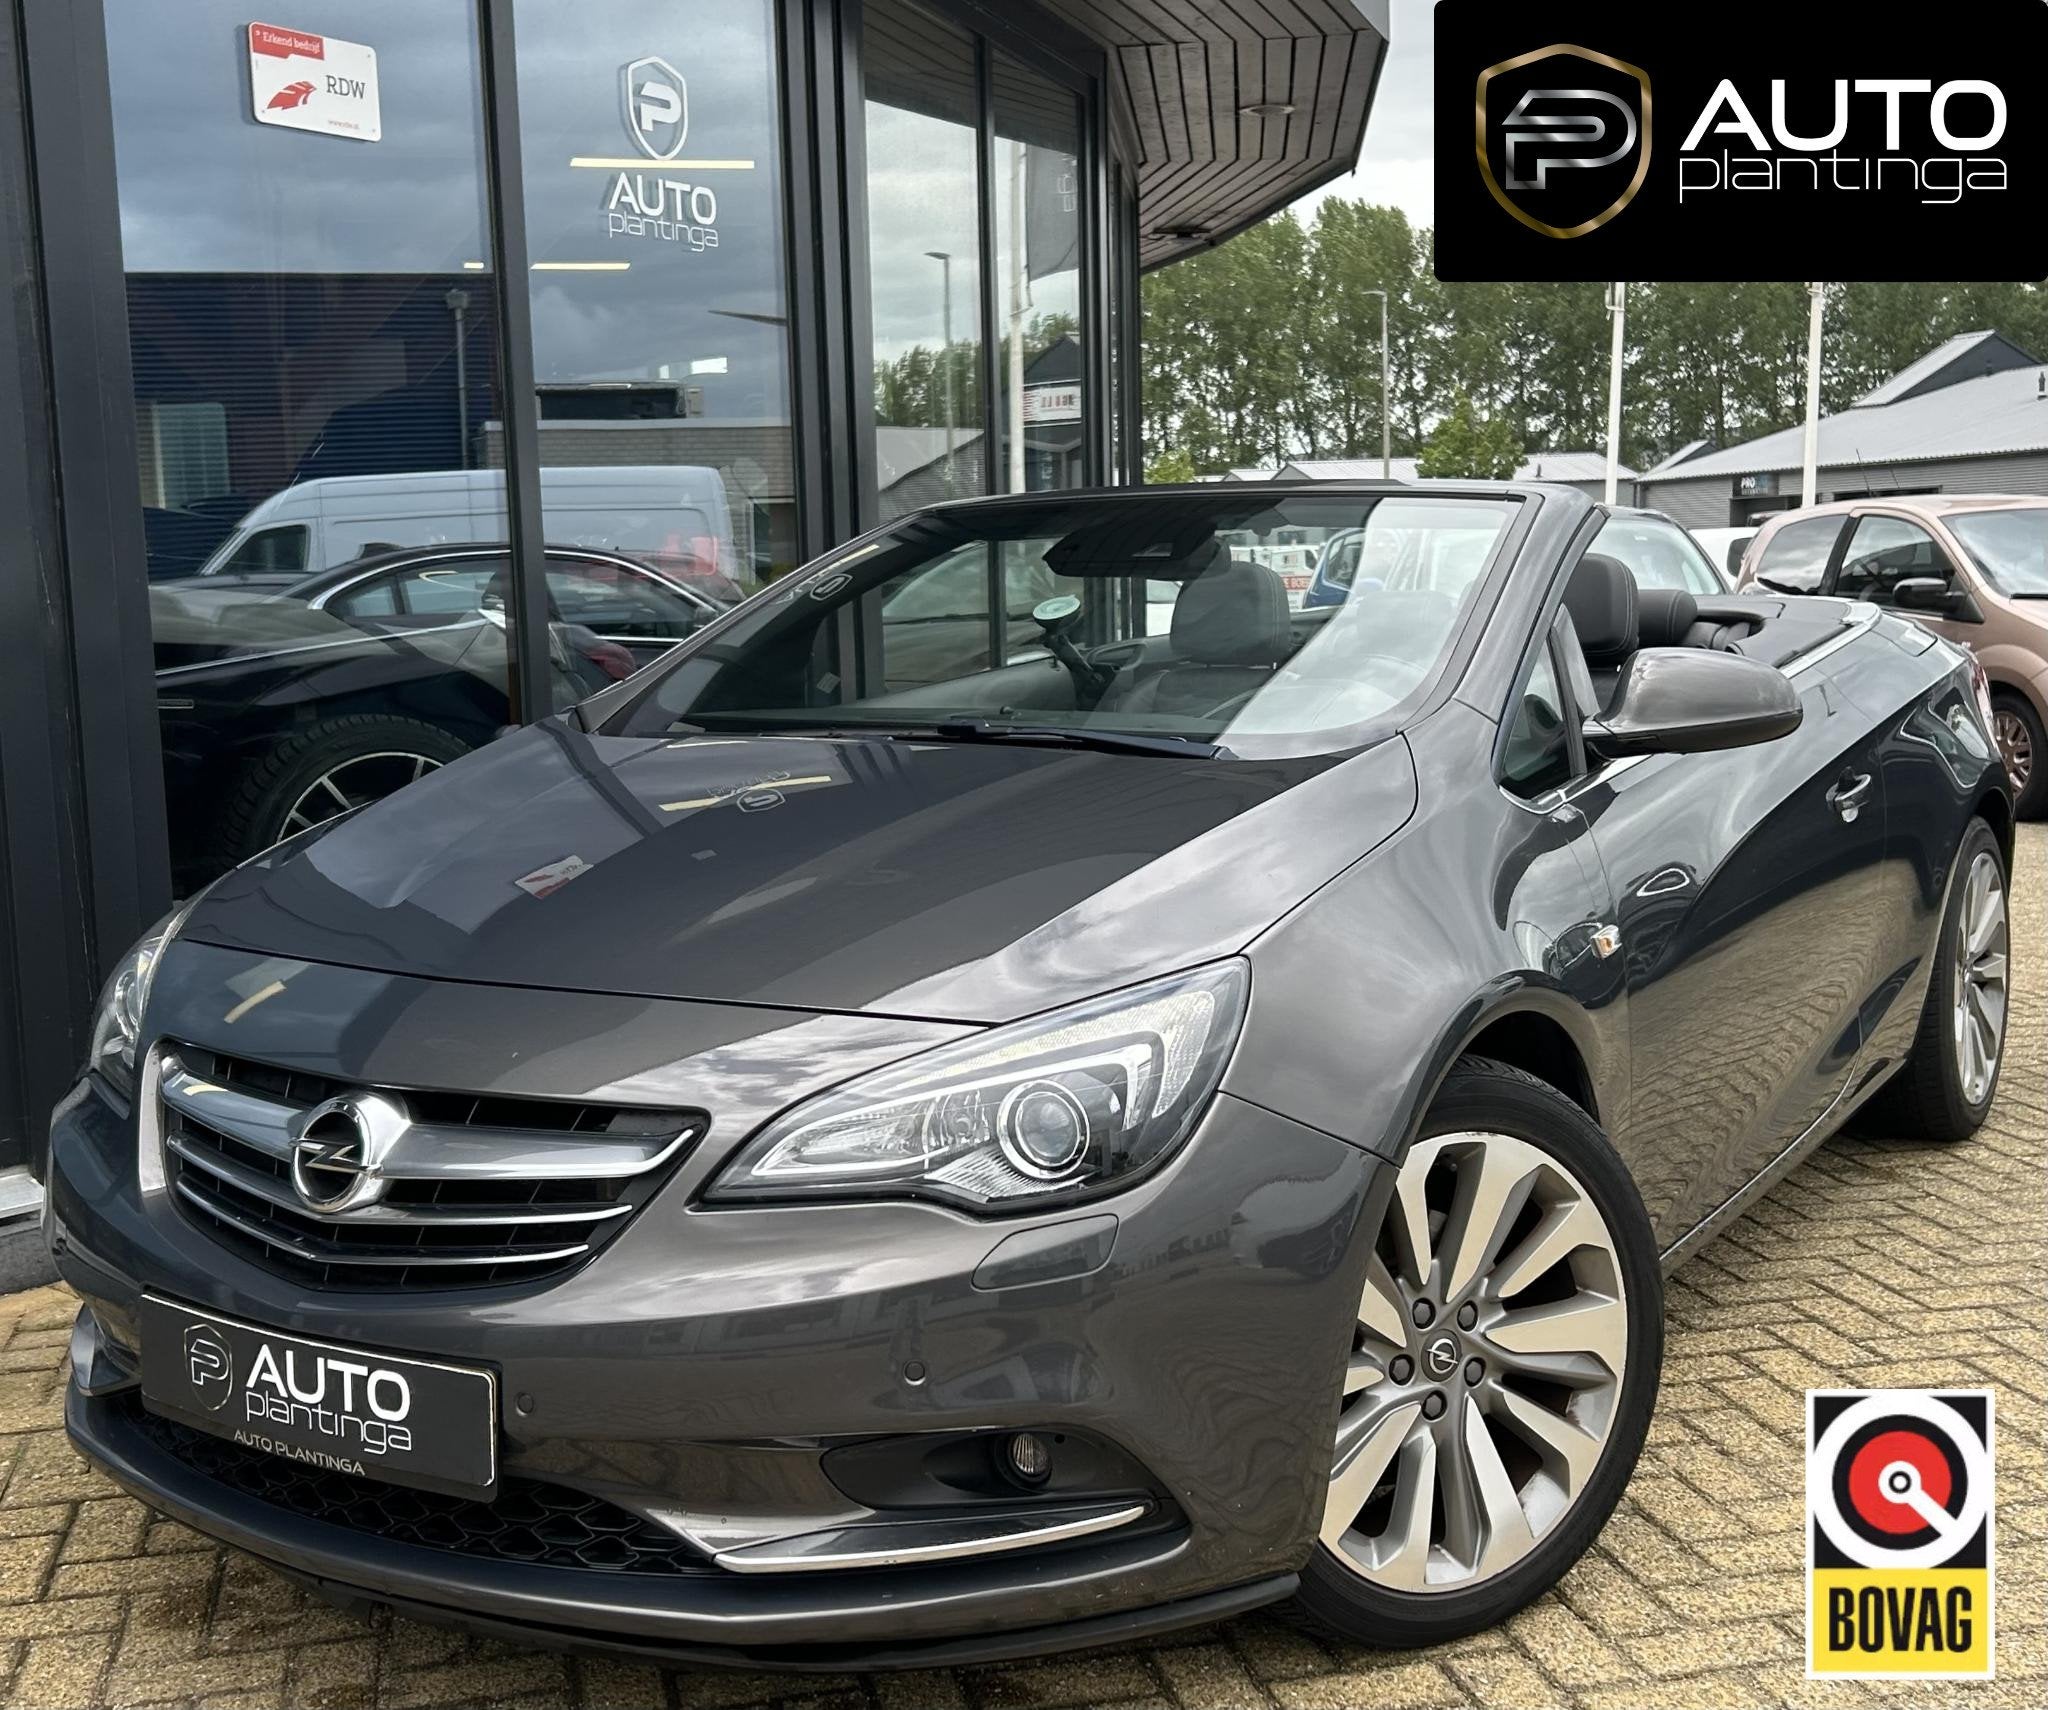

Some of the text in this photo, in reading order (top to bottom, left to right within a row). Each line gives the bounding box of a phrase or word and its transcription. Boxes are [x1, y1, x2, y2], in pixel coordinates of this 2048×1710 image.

[262, 31, 293, 48] Erkend
[325, 74, 367, 99] RDW
[609, 171, 717, 225] AUTO
[608, 210, 719, 252] plantinga
[246, 1343, 411, 1422] AUTO
[246, 1390, 412, 1455] plantinga
[233, 1428, 366, 1477] AUTO PLANTINGA
